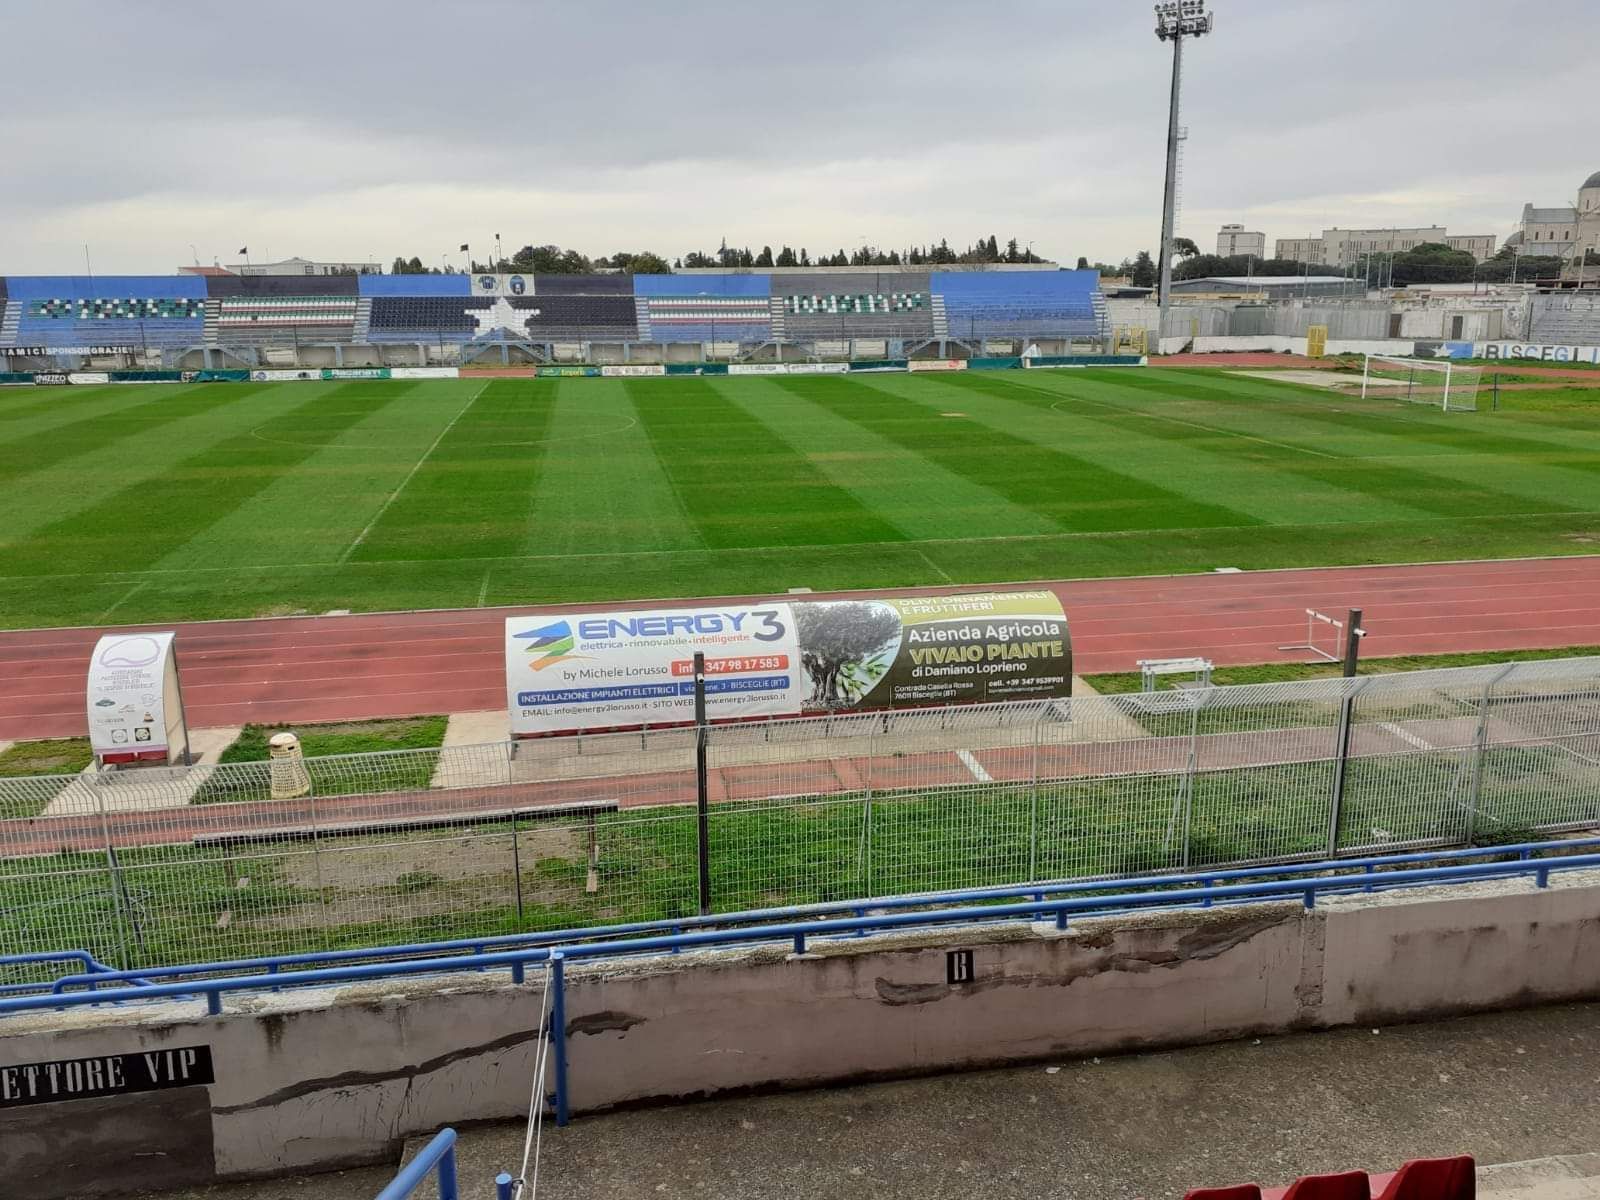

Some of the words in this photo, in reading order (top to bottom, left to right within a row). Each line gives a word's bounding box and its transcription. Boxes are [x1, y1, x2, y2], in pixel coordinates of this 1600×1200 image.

[899, 596, 936, 607] OLIVI
[903, 606, 911, 615] E
[912, 602, 994, 614] FRUTTIFERI
[578, 612, 748, 640] ENERGY
[751, 610, 786, 642] 3
[908, 626, 981, 643] Azienda
[985, 621, 1060, 642] Agricola
[692, 634, 750, 646] intelligente
[909, 645, 984, 665] VIVAIO
[987, 641, 1064, 661] PIANTE
[705, 661, 725, 672] 347
[728, 660, 742, 670] 98
[744, 659, 757, 669] 17
[759, 657, 780, 668] 583
[912, 665, 923, 678] di
[925, 663, 975, 677] Damiano
[976, 661, 1027, 674] Loprieno
[563, 669, 577, 681] by
[579, 667, 624, 679] Michele
[626, 666, 668, 677] Lorusso
[730, 679, 769, 690] BISCEGLIE
[521, 691, 590, 703] INSTALLAZIONE
[591, 688, 631, 699] IMPIANTI
[633, 686, 674, 697] ELETTRICI
[522, 708, 552, 718] EMAIL:
[653, 700, 673, 708] SITO
[2, 1056, 126, 1100] ETTORE
[144, 1048, 197, 1083] VIP
